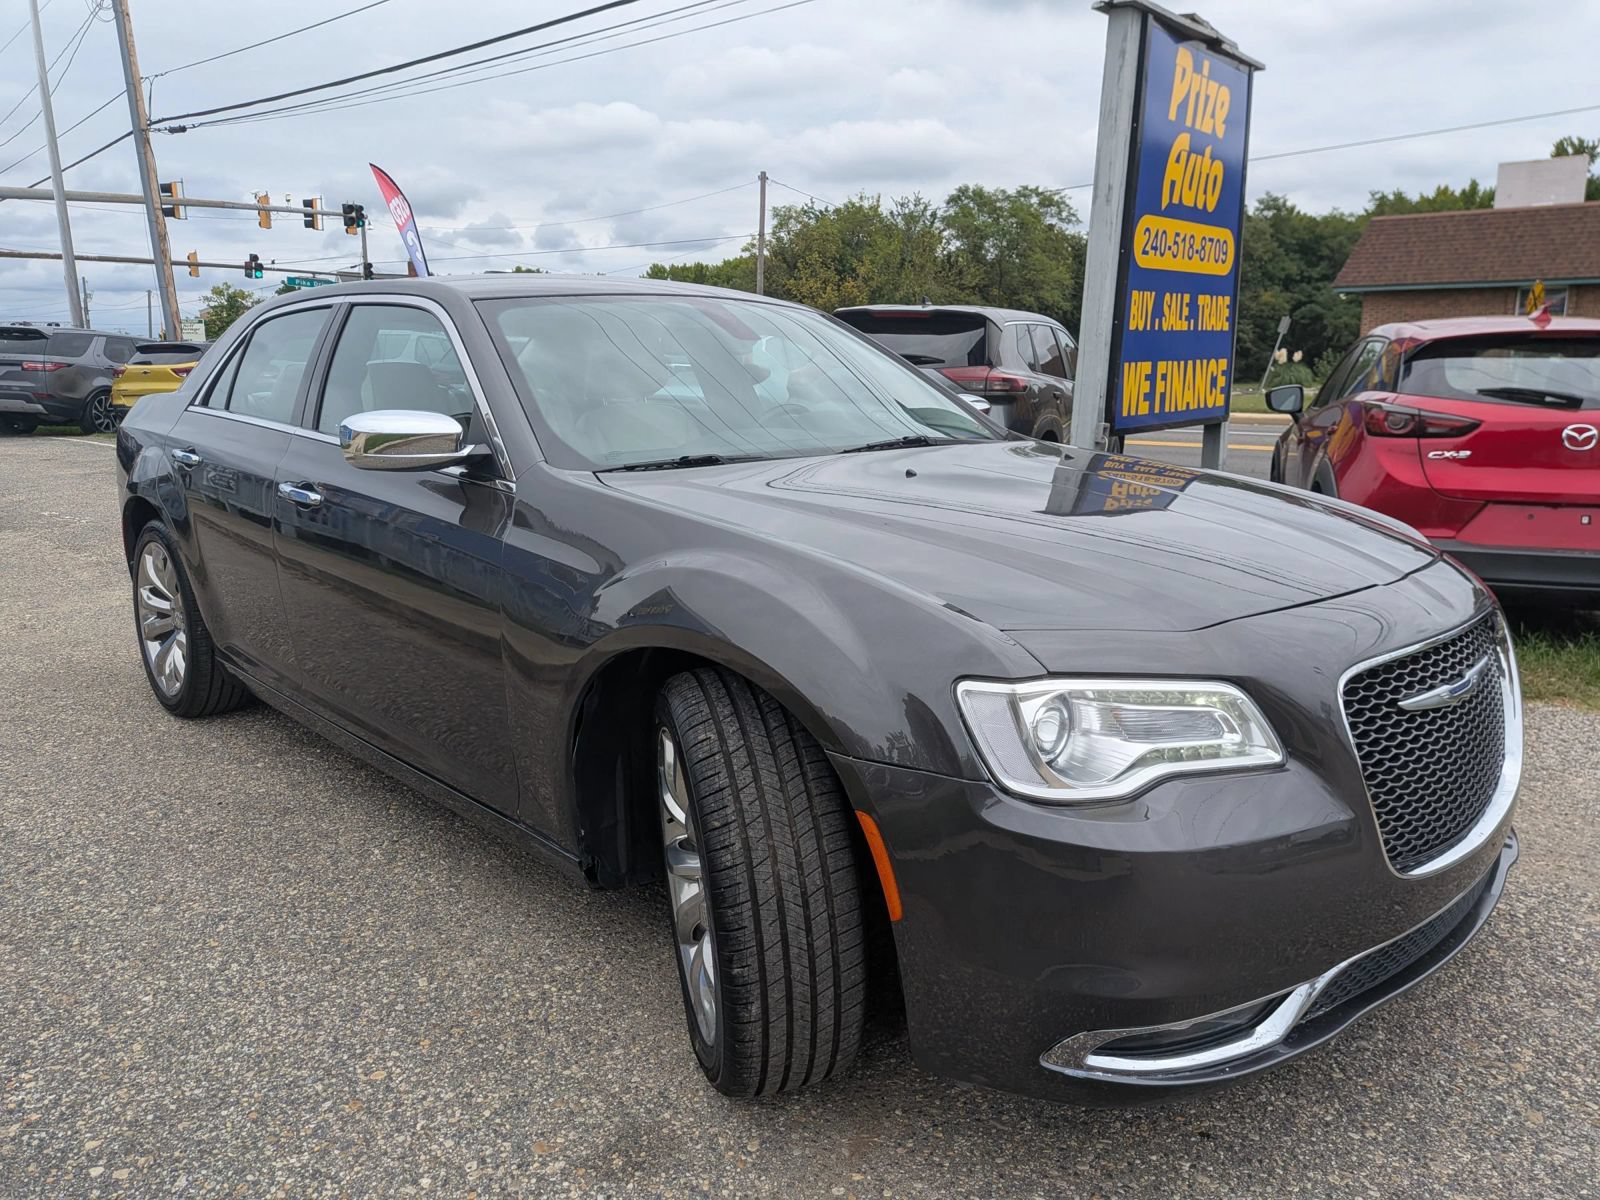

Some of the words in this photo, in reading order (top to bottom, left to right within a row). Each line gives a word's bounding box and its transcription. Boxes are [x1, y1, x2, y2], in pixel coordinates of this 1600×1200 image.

[1168, 46, 1231, 140] Prize
[1161, 132, 1225, 213] Auto
[1141, 227, 1229, 265] 240-518-8709
[1129, 290, 1155, 331] BUY
[1162, 292, 1190, 332] SALE
[1197, 294, 1231, 331] TRADE
[1122, 361, 1152, 417] WE
[1154, 358, 1228, 414] FINANCE
